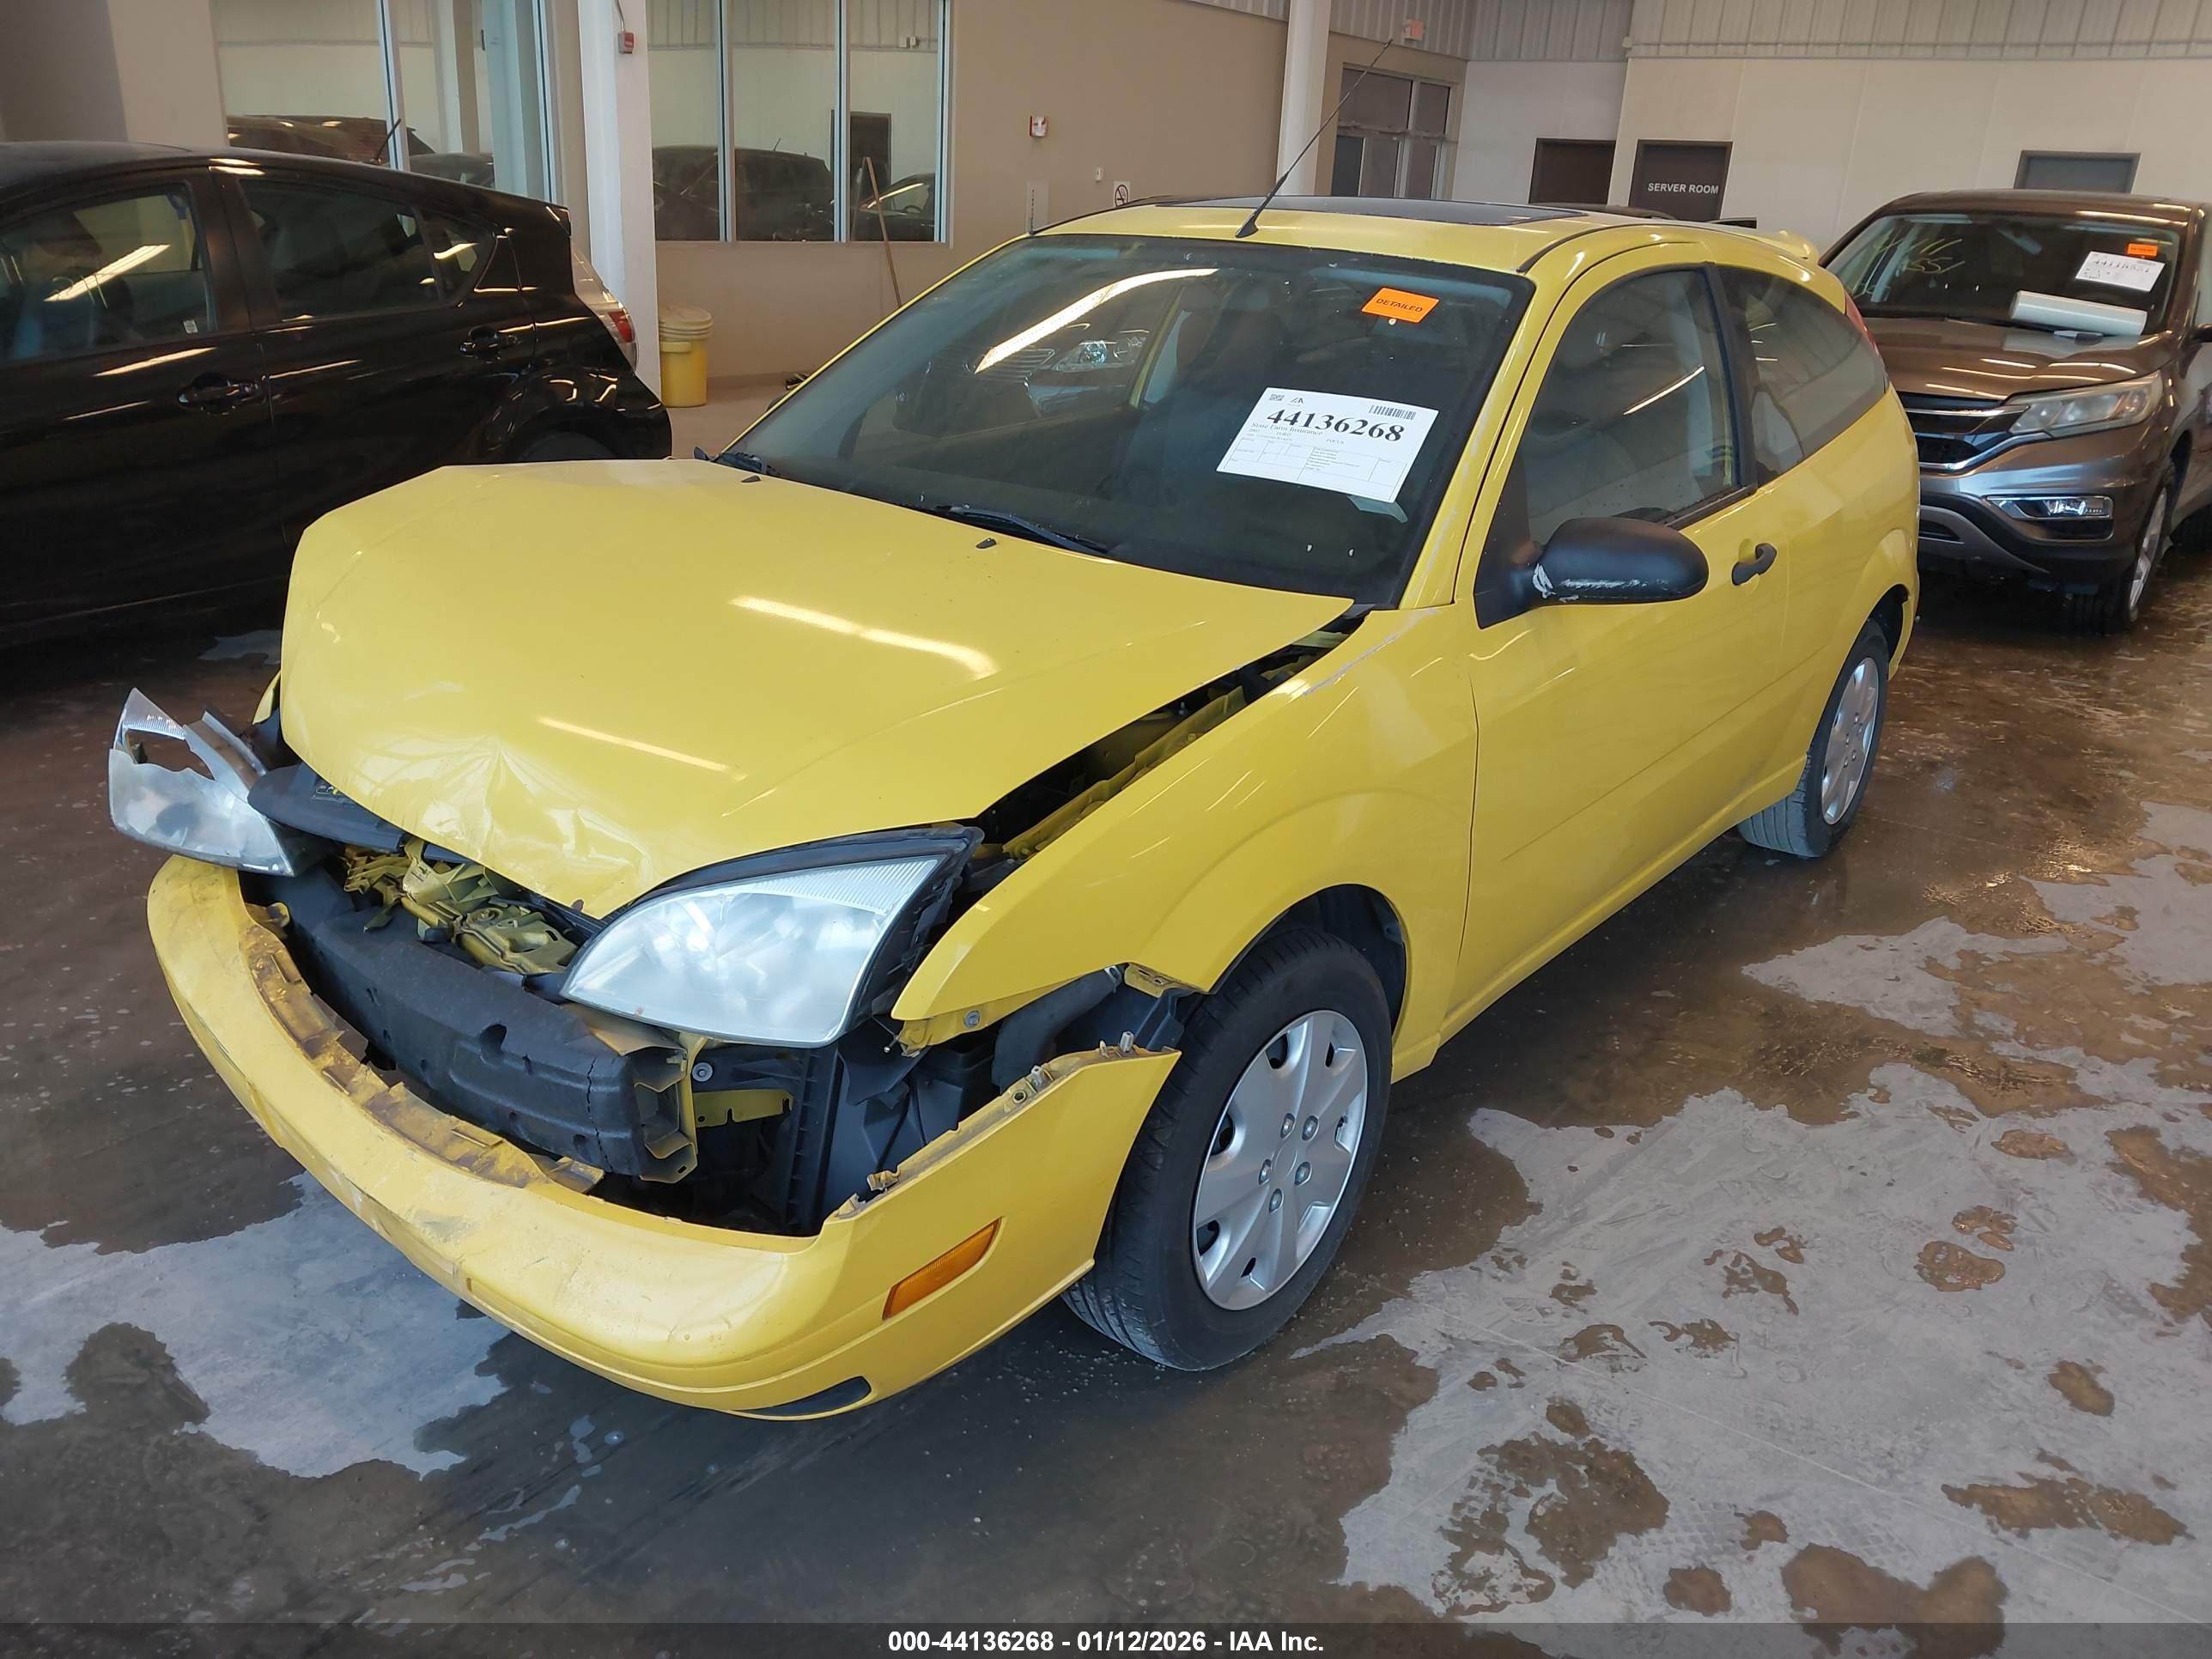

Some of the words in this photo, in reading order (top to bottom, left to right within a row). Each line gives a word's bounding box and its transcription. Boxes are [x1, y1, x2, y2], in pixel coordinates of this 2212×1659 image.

[1648, 182, 1686, 192] SERVER
[1688, 184, 1719, 194] ROOM
[1376, 298, 1423, 312] DETAILED
[1267, 409, 1405, 442] 44136268
[1290, 426, 1323, 436] Insurance
